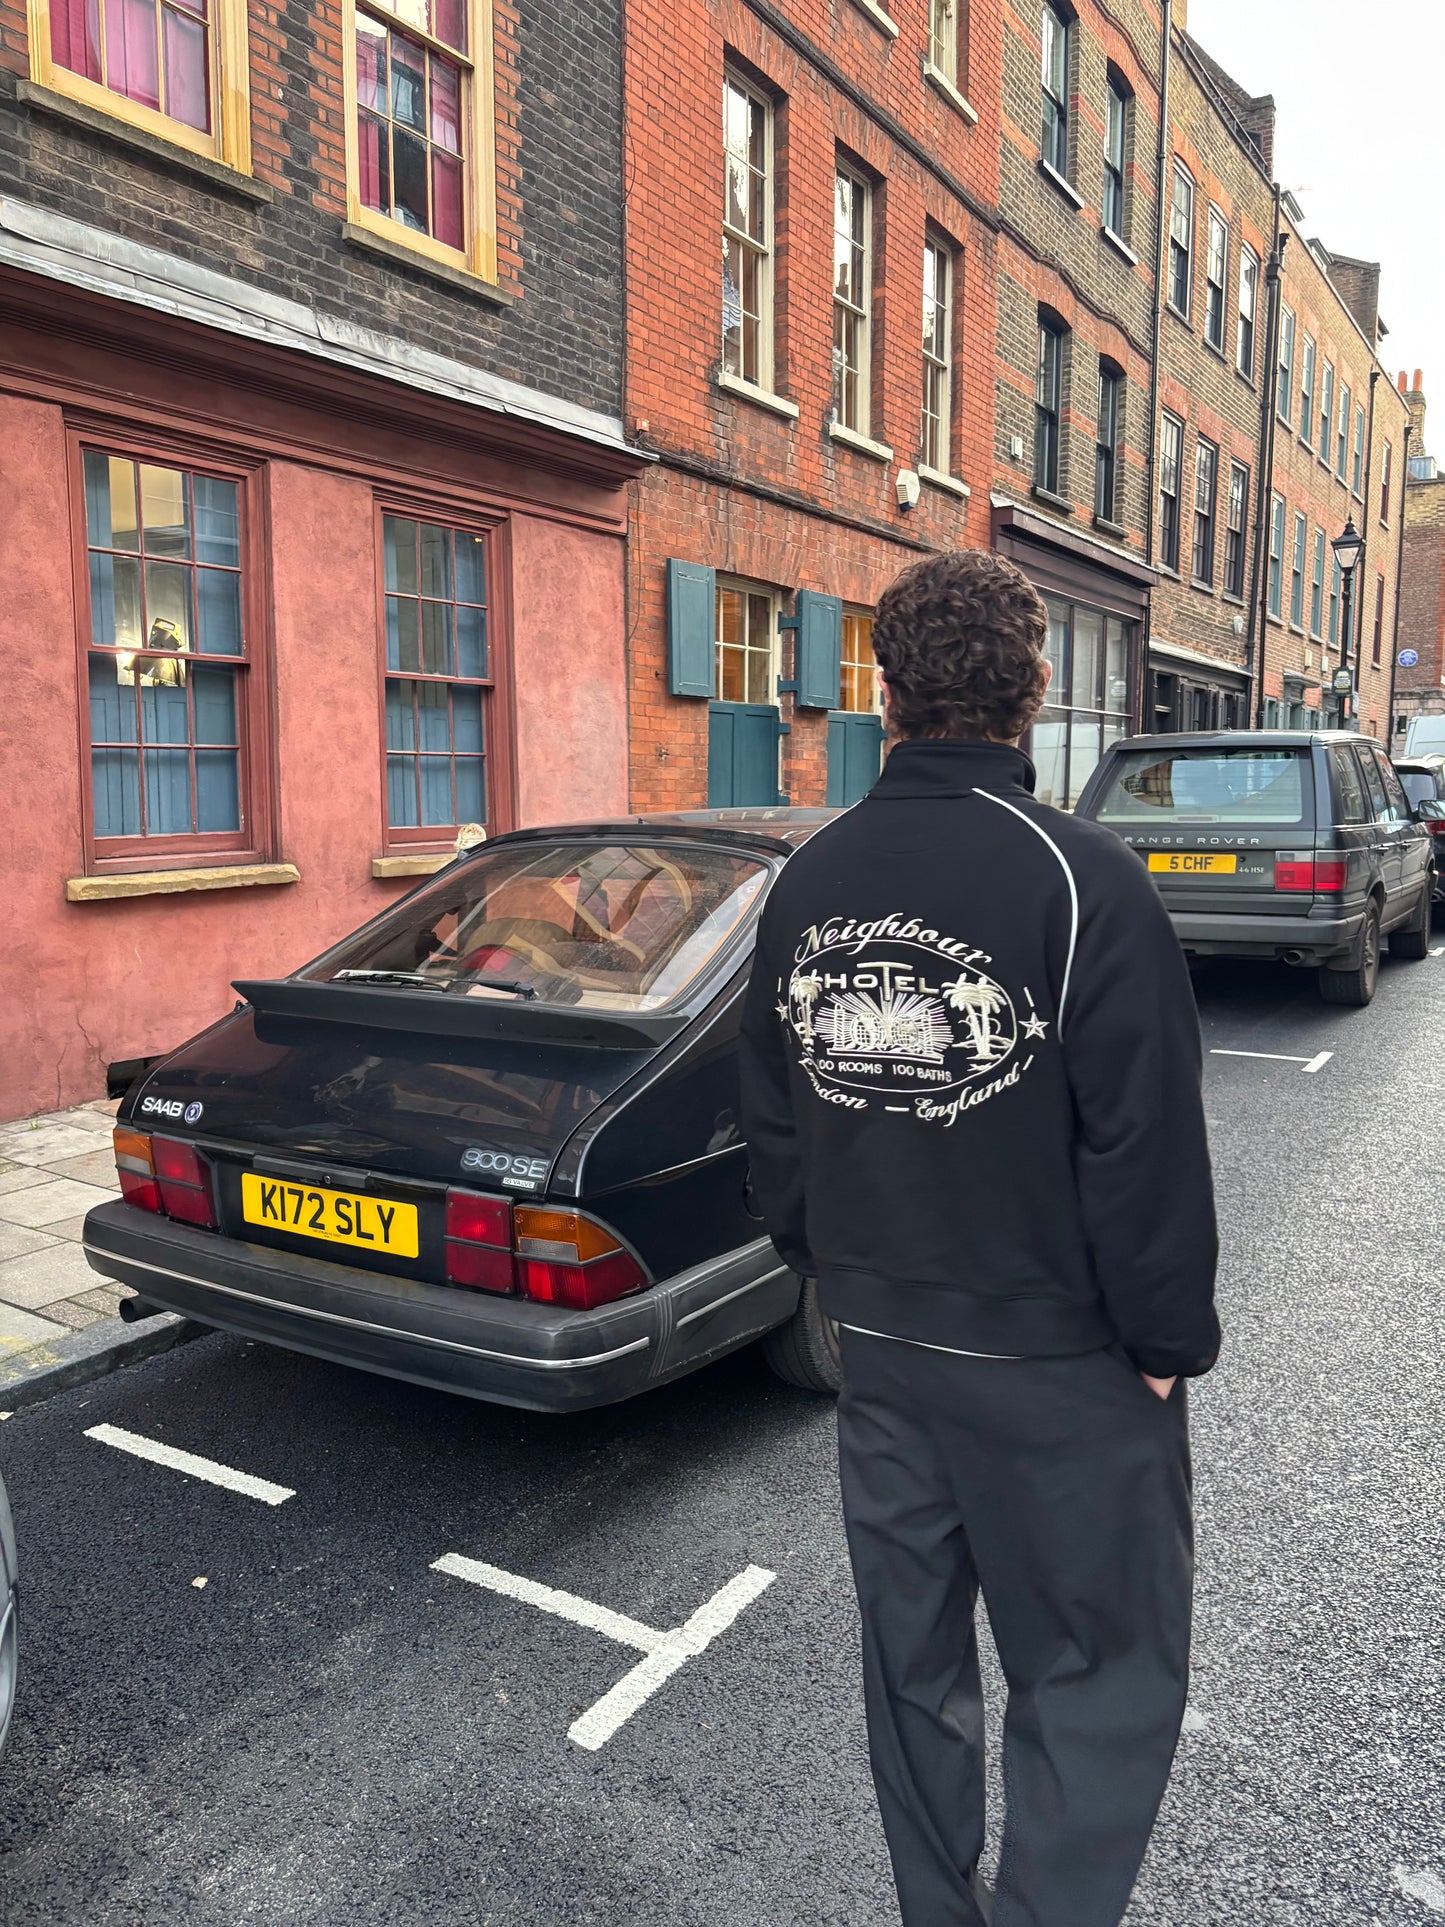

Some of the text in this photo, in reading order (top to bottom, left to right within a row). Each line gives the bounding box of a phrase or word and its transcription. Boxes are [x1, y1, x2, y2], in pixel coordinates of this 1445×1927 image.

[1124, 836, 1261, 845] RANGE ROVER
[1169, 856, 1214, 871] 5 CHF
[794, 912, 993, 964] Neighbour
[824, 961, 940, 1001] HOTEL
[838, 1061, 883, 1075] ROOMS
[892, 1064, 915, 1077] 100
[916, 1067, 953, 1083] BATHS
[141, 1096, 184, 1117] SAAB
[914, 1061, 1021, 1127] England
[260, 1182, 396, 1244] K172 SLY
